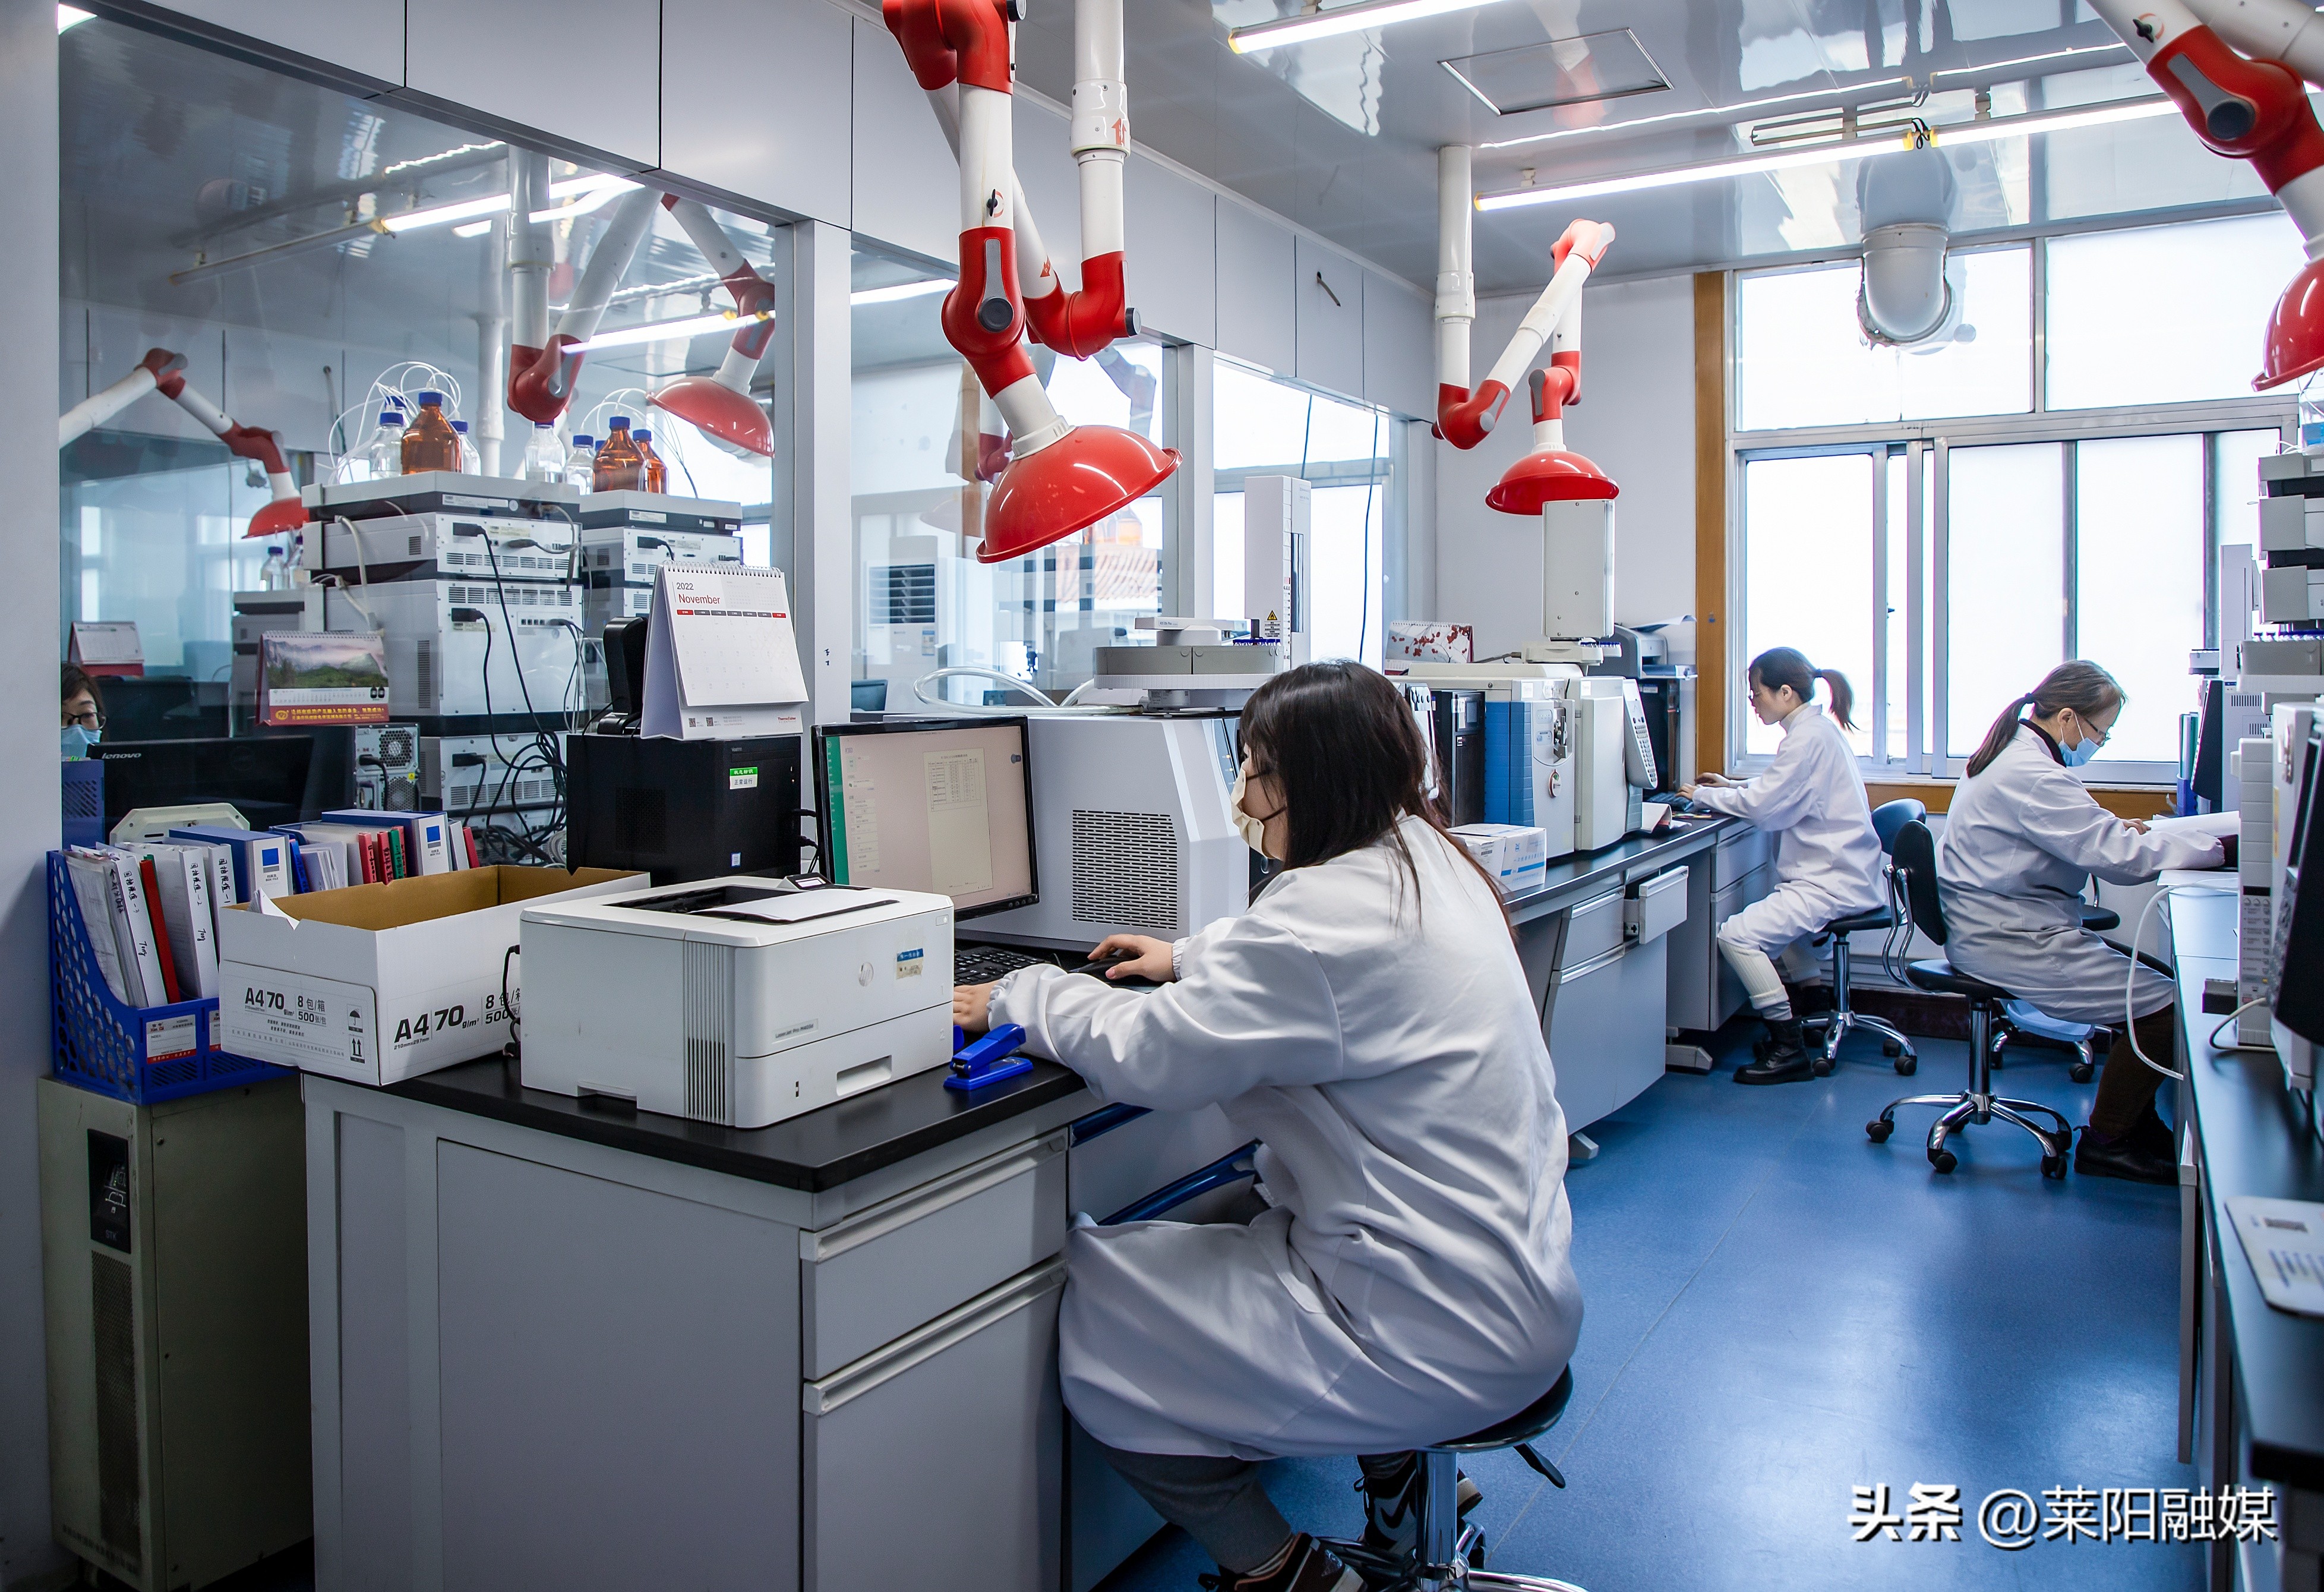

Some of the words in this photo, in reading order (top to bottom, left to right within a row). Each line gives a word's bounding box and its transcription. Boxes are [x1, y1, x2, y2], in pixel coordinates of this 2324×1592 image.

[676, 582, 694, 590] 2022
[678, 594, 721, 604] November
[245, 987, 264, 1007] A4
[267, 991, 285, 1010] 70
[298, 995, 304, 1008] 8
[307, 999, 326, 1012] 包/箱
[485, 994, 495, 1009] 8
[394, 1013, 430, 1043] A4
[434, 1005, 465, 1032] 70
[106, 1230, 118, 1241] STK
